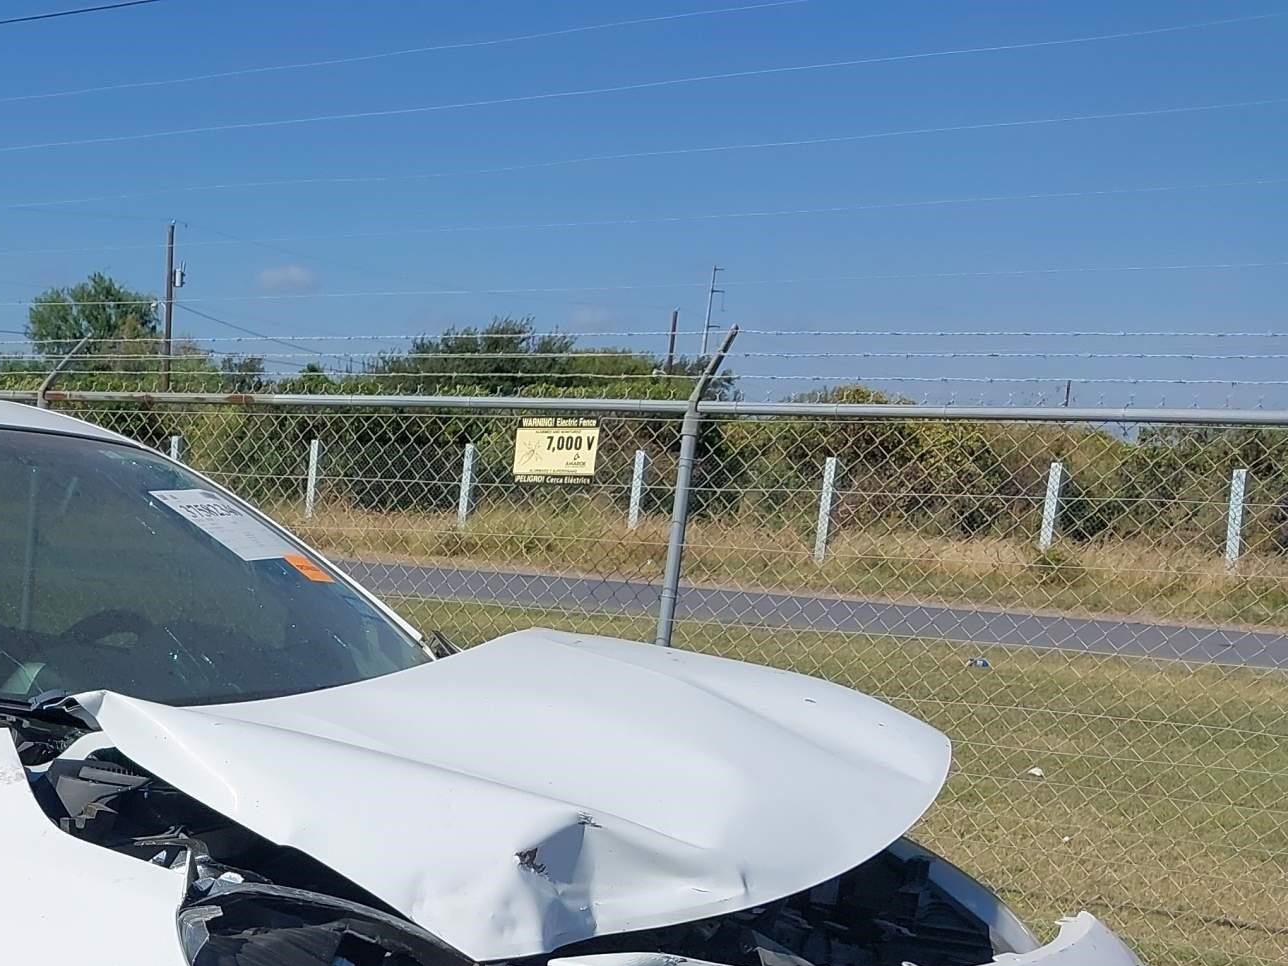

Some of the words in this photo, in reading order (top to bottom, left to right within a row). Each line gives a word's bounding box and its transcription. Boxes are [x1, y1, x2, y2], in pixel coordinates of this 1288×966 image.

[523, 417, 554, 427] WARNING!
[556, 417, 578, 427] Electric
[579, 417, 596, 427] Fence
[546, 436, 582, 452] 7,000
[587, 436, 595, 450] V
